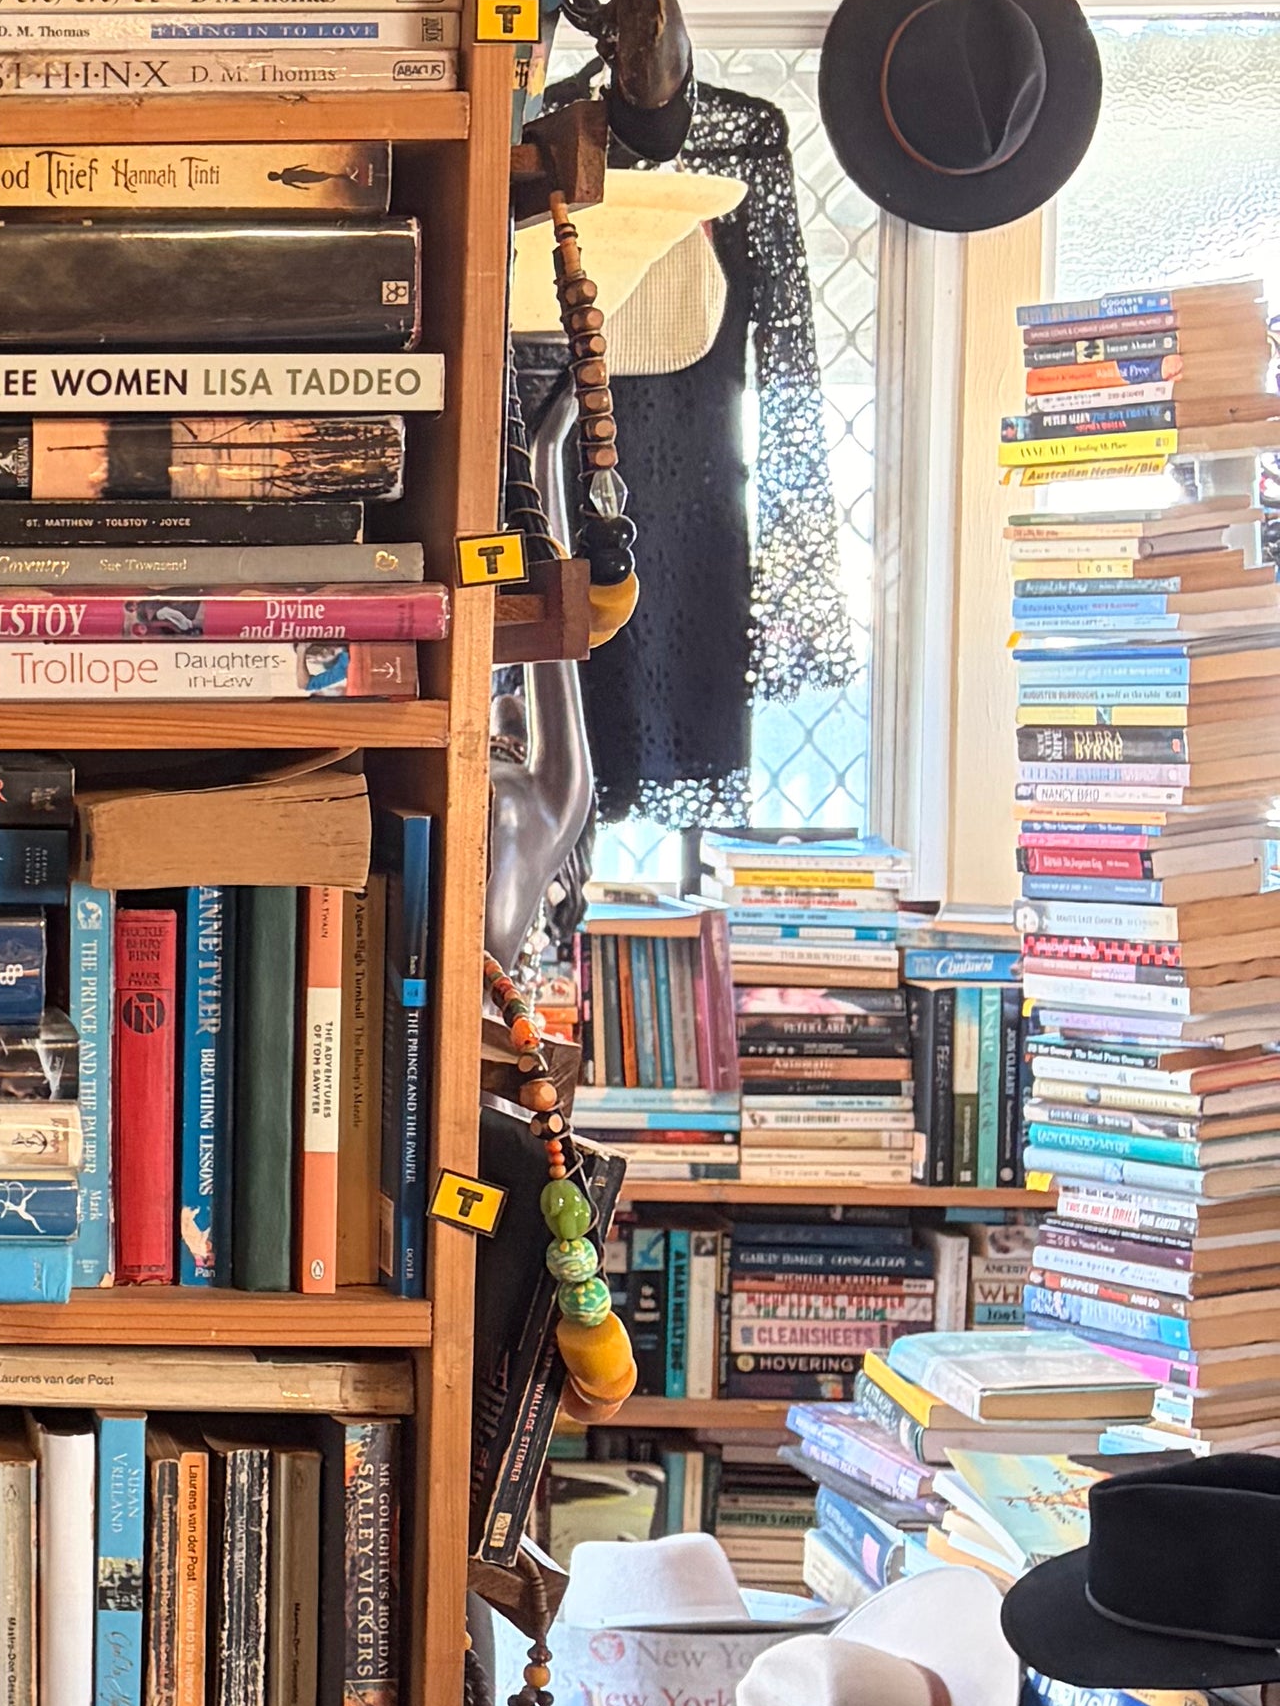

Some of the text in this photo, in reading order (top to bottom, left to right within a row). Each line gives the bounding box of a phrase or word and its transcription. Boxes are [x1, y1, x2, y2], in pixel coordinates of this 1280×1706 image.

[496, 4, 520, 32] T
[52, 368, 188, 396] WOMEN
[202, 368, 274, 395] LISA
[285, 368, 421, 396] TADDEO
[474, 545, 502, 575] T
[457, 1188, 482, 1216] T
[757, 1327, 874, 1349] CLEANSHEETS
[760, 1356, 854, 1373] HOVERING
